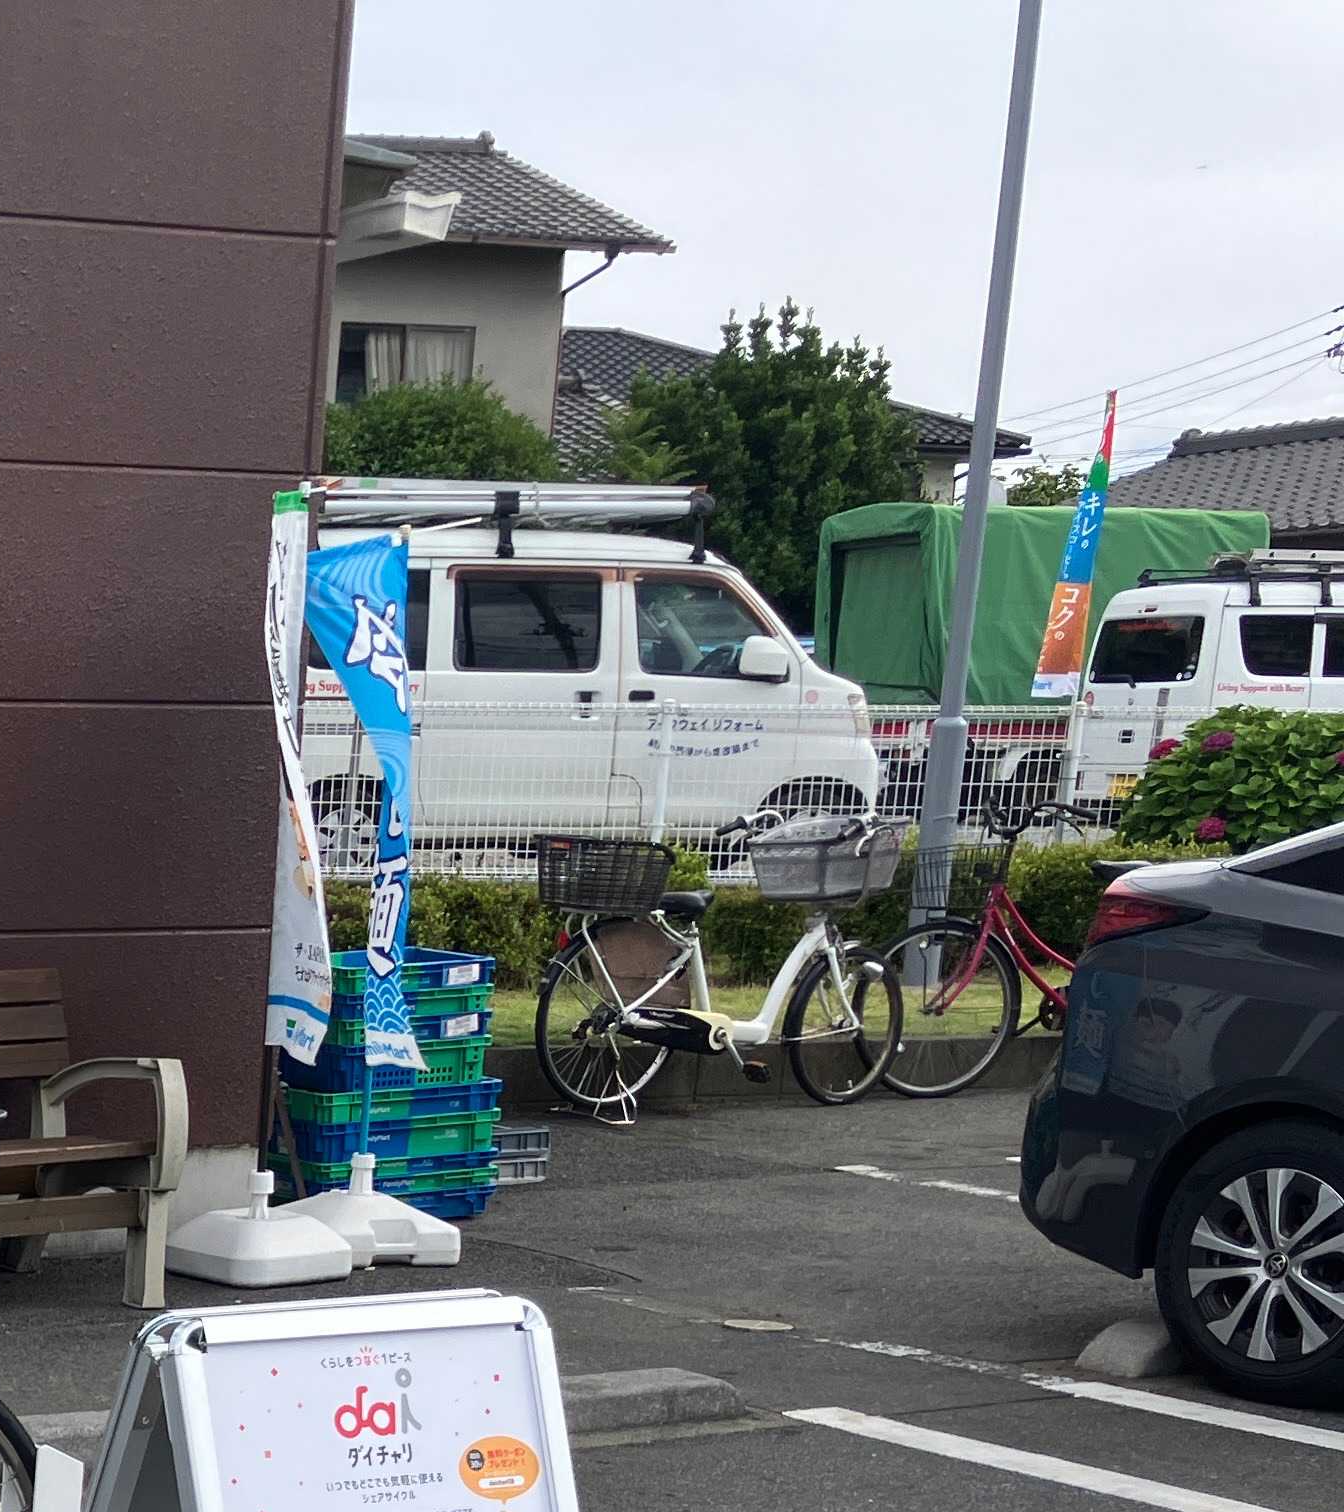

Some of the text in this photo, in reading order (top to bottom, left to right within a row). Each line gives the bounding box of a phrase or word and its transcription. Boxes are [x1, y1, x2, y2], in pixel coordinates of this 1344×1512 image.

[320, 1352, 412, 1368] くらしをつなぐ1ピース
[348, 1443, 413, 1468] ダイチャリ
[326, 1472, 444, 1492] いつでもどこでも気軽に使える
[362, 1490, 416, 1504] シェアサイクル
